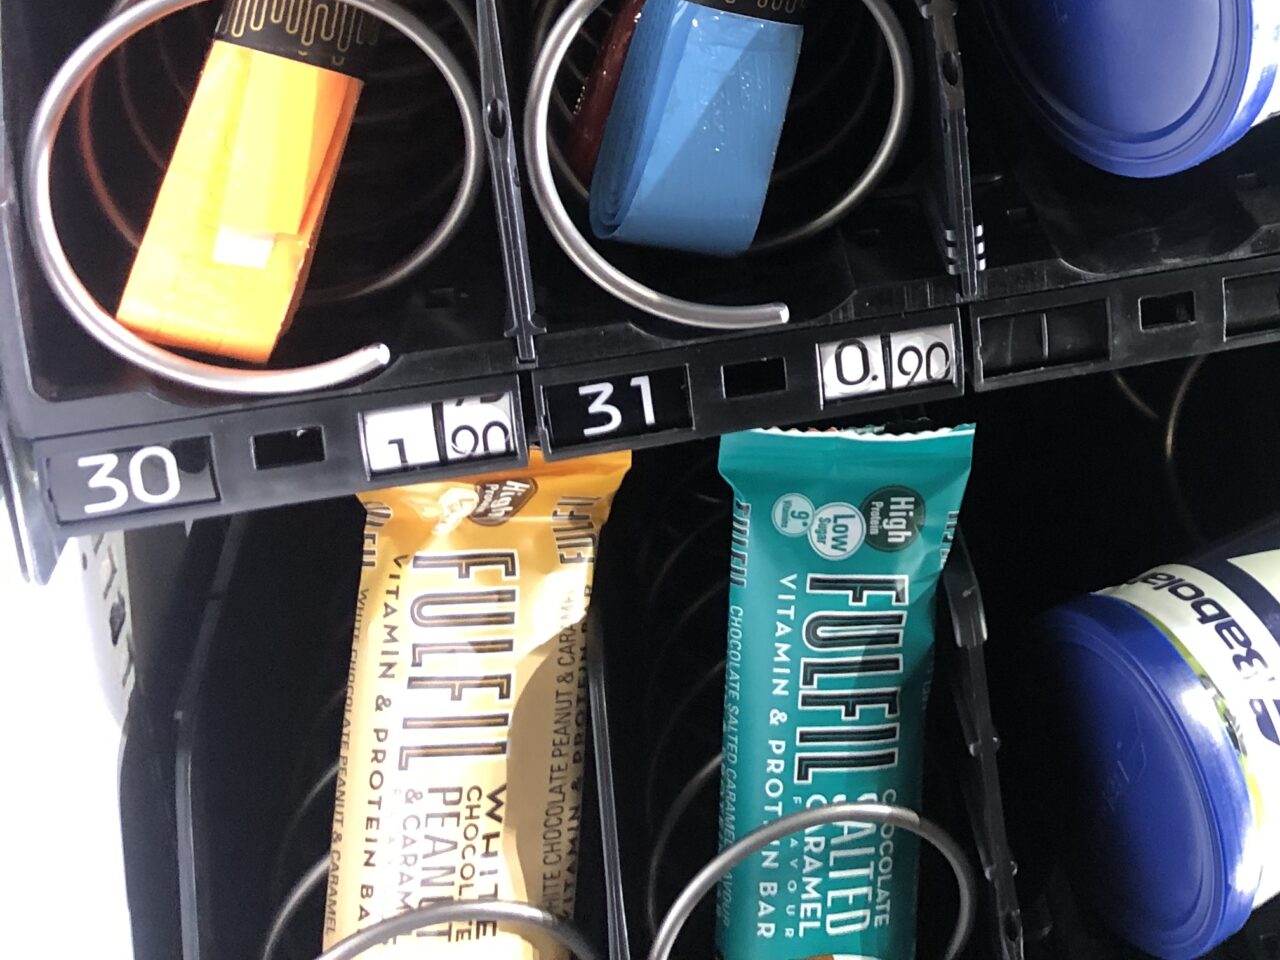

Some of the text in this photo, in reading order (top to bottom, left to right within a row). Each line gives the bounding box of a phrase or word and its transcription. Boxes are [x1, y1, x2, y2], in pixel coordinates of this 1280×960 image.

[578, 375, 656, 438] 31
[77, 445, 181, 514] 30
[490, 479, 530, 518] High
[814, 516, 832, 545] Sugar
[830, 513, 856, 552] Low
[869, 500, 885, 536] Protein
[882, 496, 915, 544] High
[377, 554, 409, 679] VITAMIN
[398, 551, 517, 771] FULFIL
[555, 671, 574, 685] &
[726, 604, 744, 701] CHOCOLATE
[793, 572, 910, 785] FULFIL
[375, 694, 392, 712] &
[551, 689, 573, 757] PEANUT
[724, 703, 740, 765] SALTED
[333, 753, 349, 828] PEANUT
[756, 573, 798, 939] VITAMIN & PROTIN BAR
[362, 727, 389, 868] PROTEIN
[404, 788, 424, 805] &
[542, 761, 569, 871] CHOCOLATE
[324, 848, 342, 936] CARAMEL
[455, 784, 483, 942] CHOCOLE
[784, 795, 803, 939] FAVOUR
[873, 788, 897, 928] COCOLATE
[356, 883, 375, 933] BA
